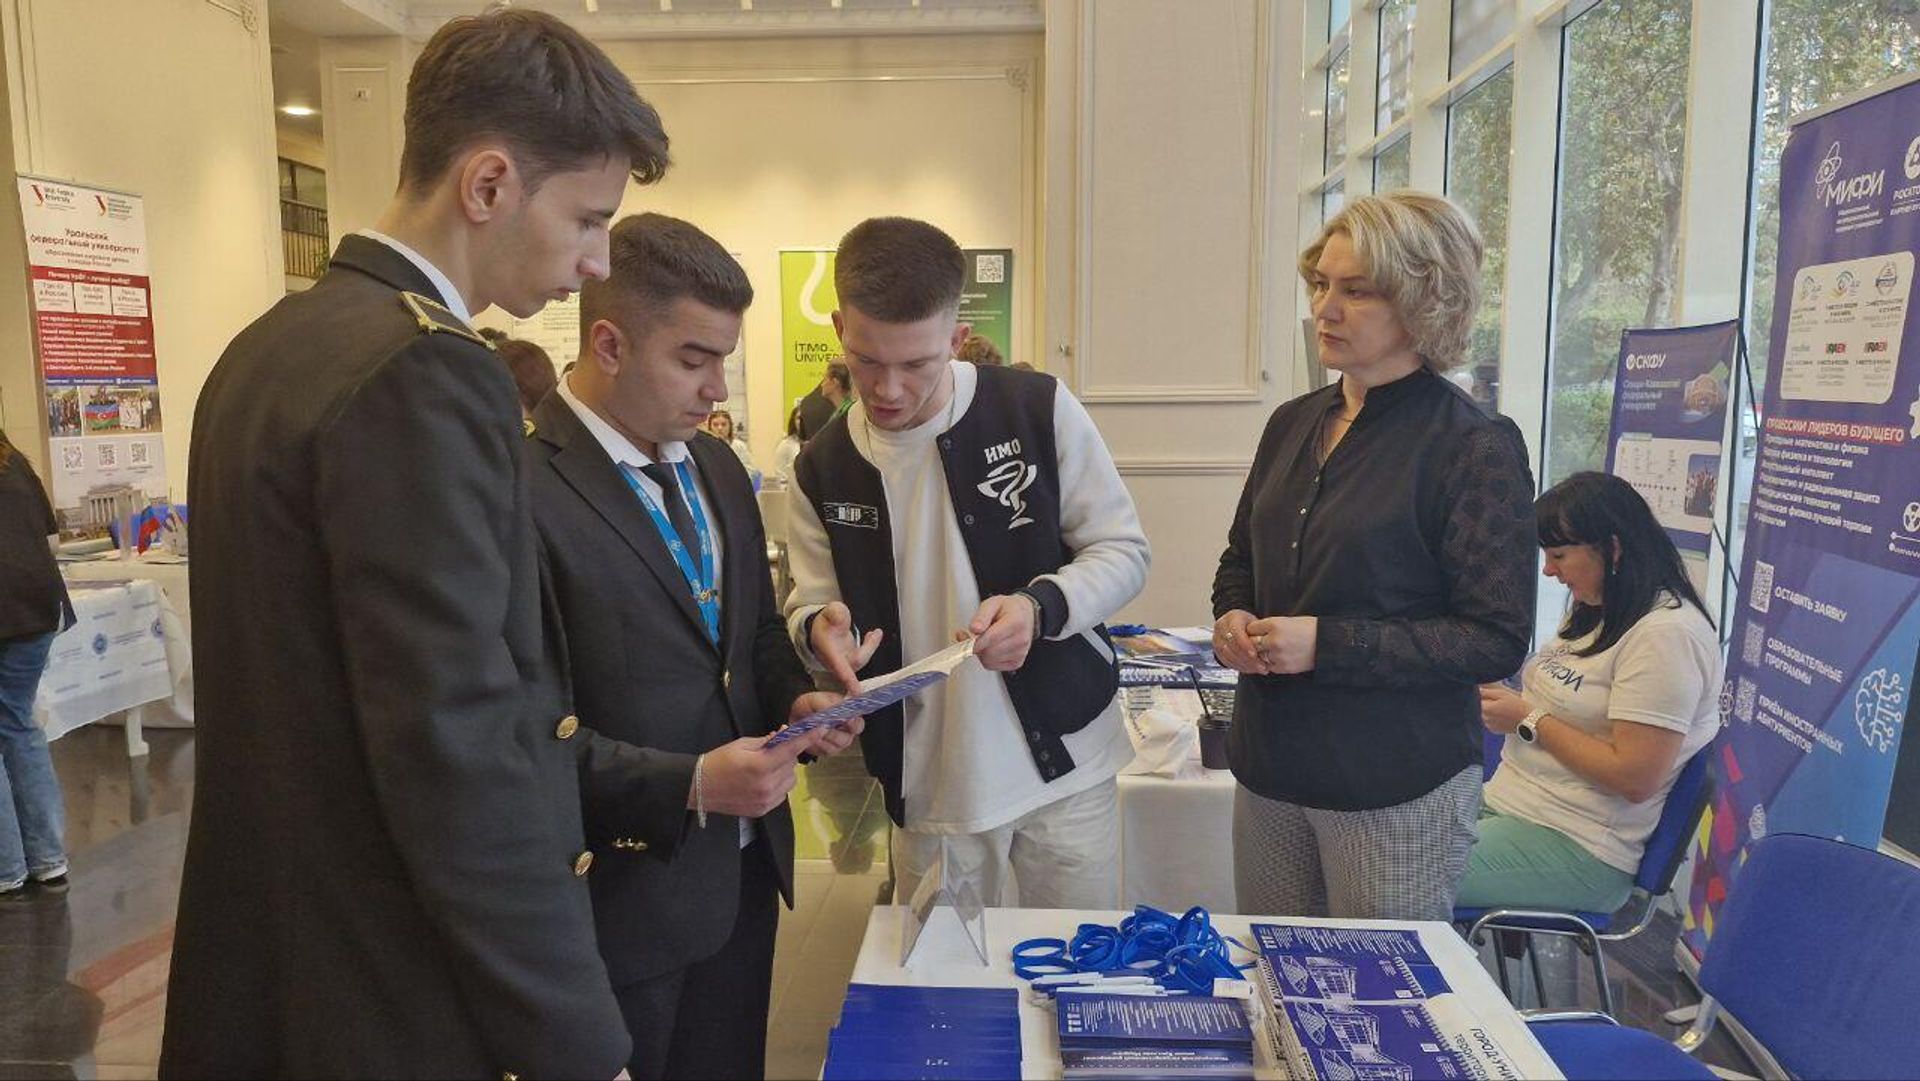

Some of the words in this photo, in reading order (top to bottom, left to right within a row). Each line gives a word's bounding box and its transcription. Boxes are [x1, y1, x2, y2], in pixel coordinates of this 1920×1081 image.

[1825, 169, 1885, 208] МИФИ
[1636, 354, 1667, 369] СКФУ
[1807, 420, 1848, 437] ЛИДЕРОВ
[1849, 424, 1905, 443] БУДУЩЕГО
[984, 438, 1022, 464] ИМО
[1775, 586, 1814, 610] ОСТАВИТЬ
[1813, 601, 1847, 622] ЗАЯВКУ
[1765, 652, 1812, 685] ПРОГРАММЫ
[1767, 637, 1844, 684] ОБРАЗОВАТЕЛЬНЫЕ
[1756, 711, 1813, 754] АБИТУРИЕНТОВ
[1783, 708, 1844, 755] ИНОСТРАННЫХ
